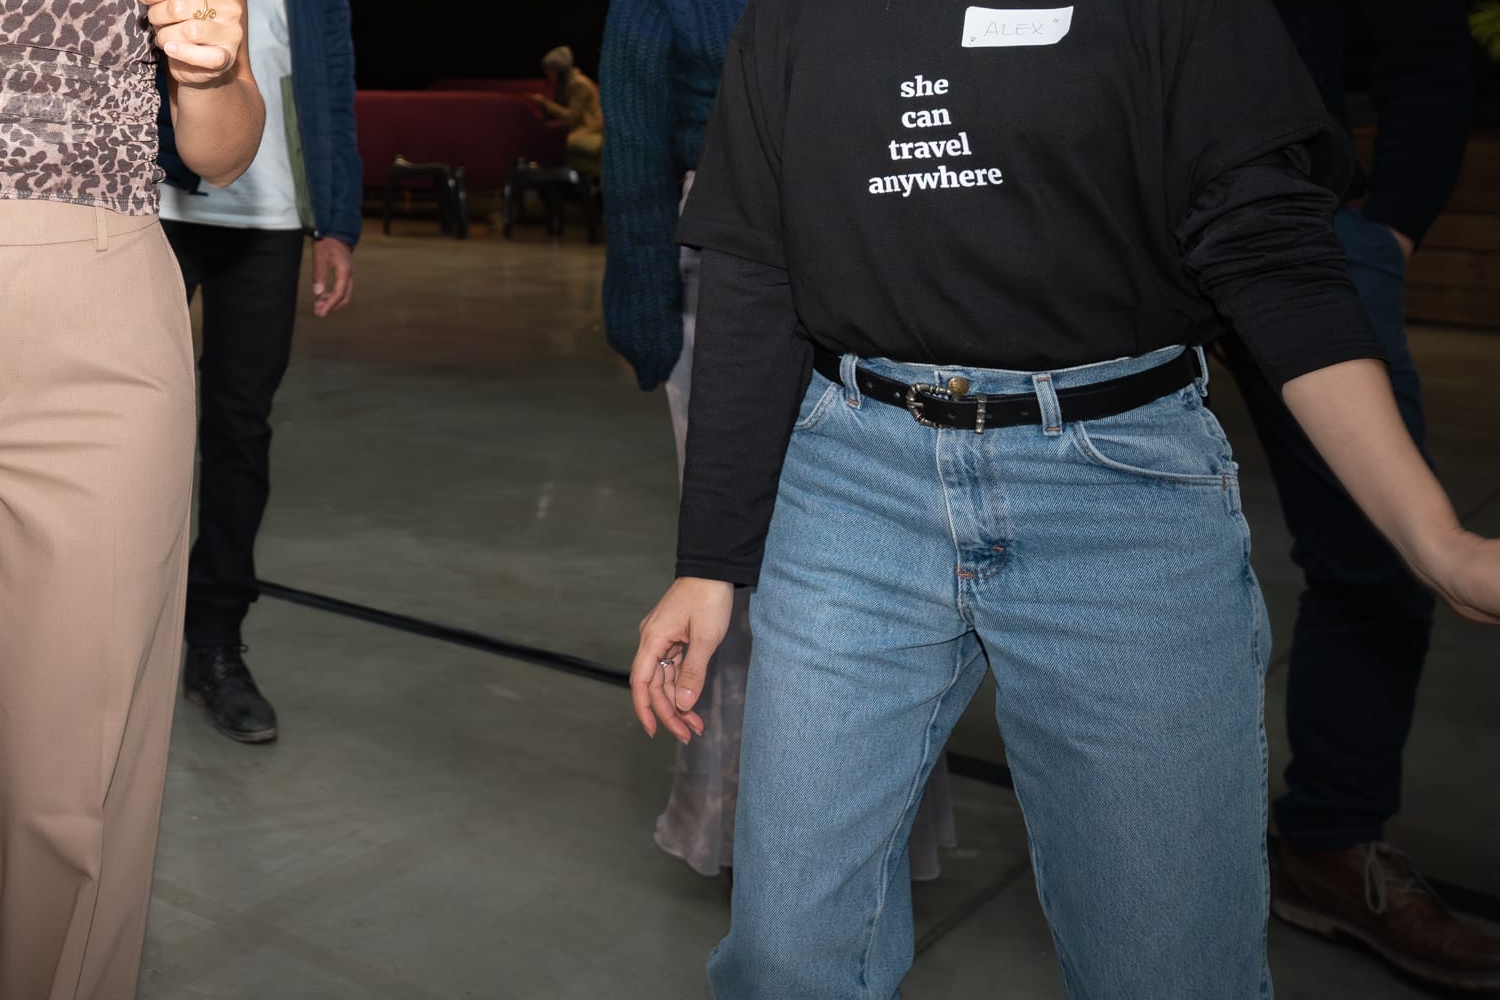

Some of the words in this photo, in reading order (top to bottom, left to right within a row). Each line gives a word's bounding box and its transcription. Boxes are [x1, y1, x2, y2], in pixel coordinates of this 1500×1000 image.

[984, 22, 1044, 37] ALEX
[900, 74, 949, 98] she
[901, 108, 951, 129] can
[888, 132, 972, 161] travel
[868, 165, 1004, 197] anywhere
